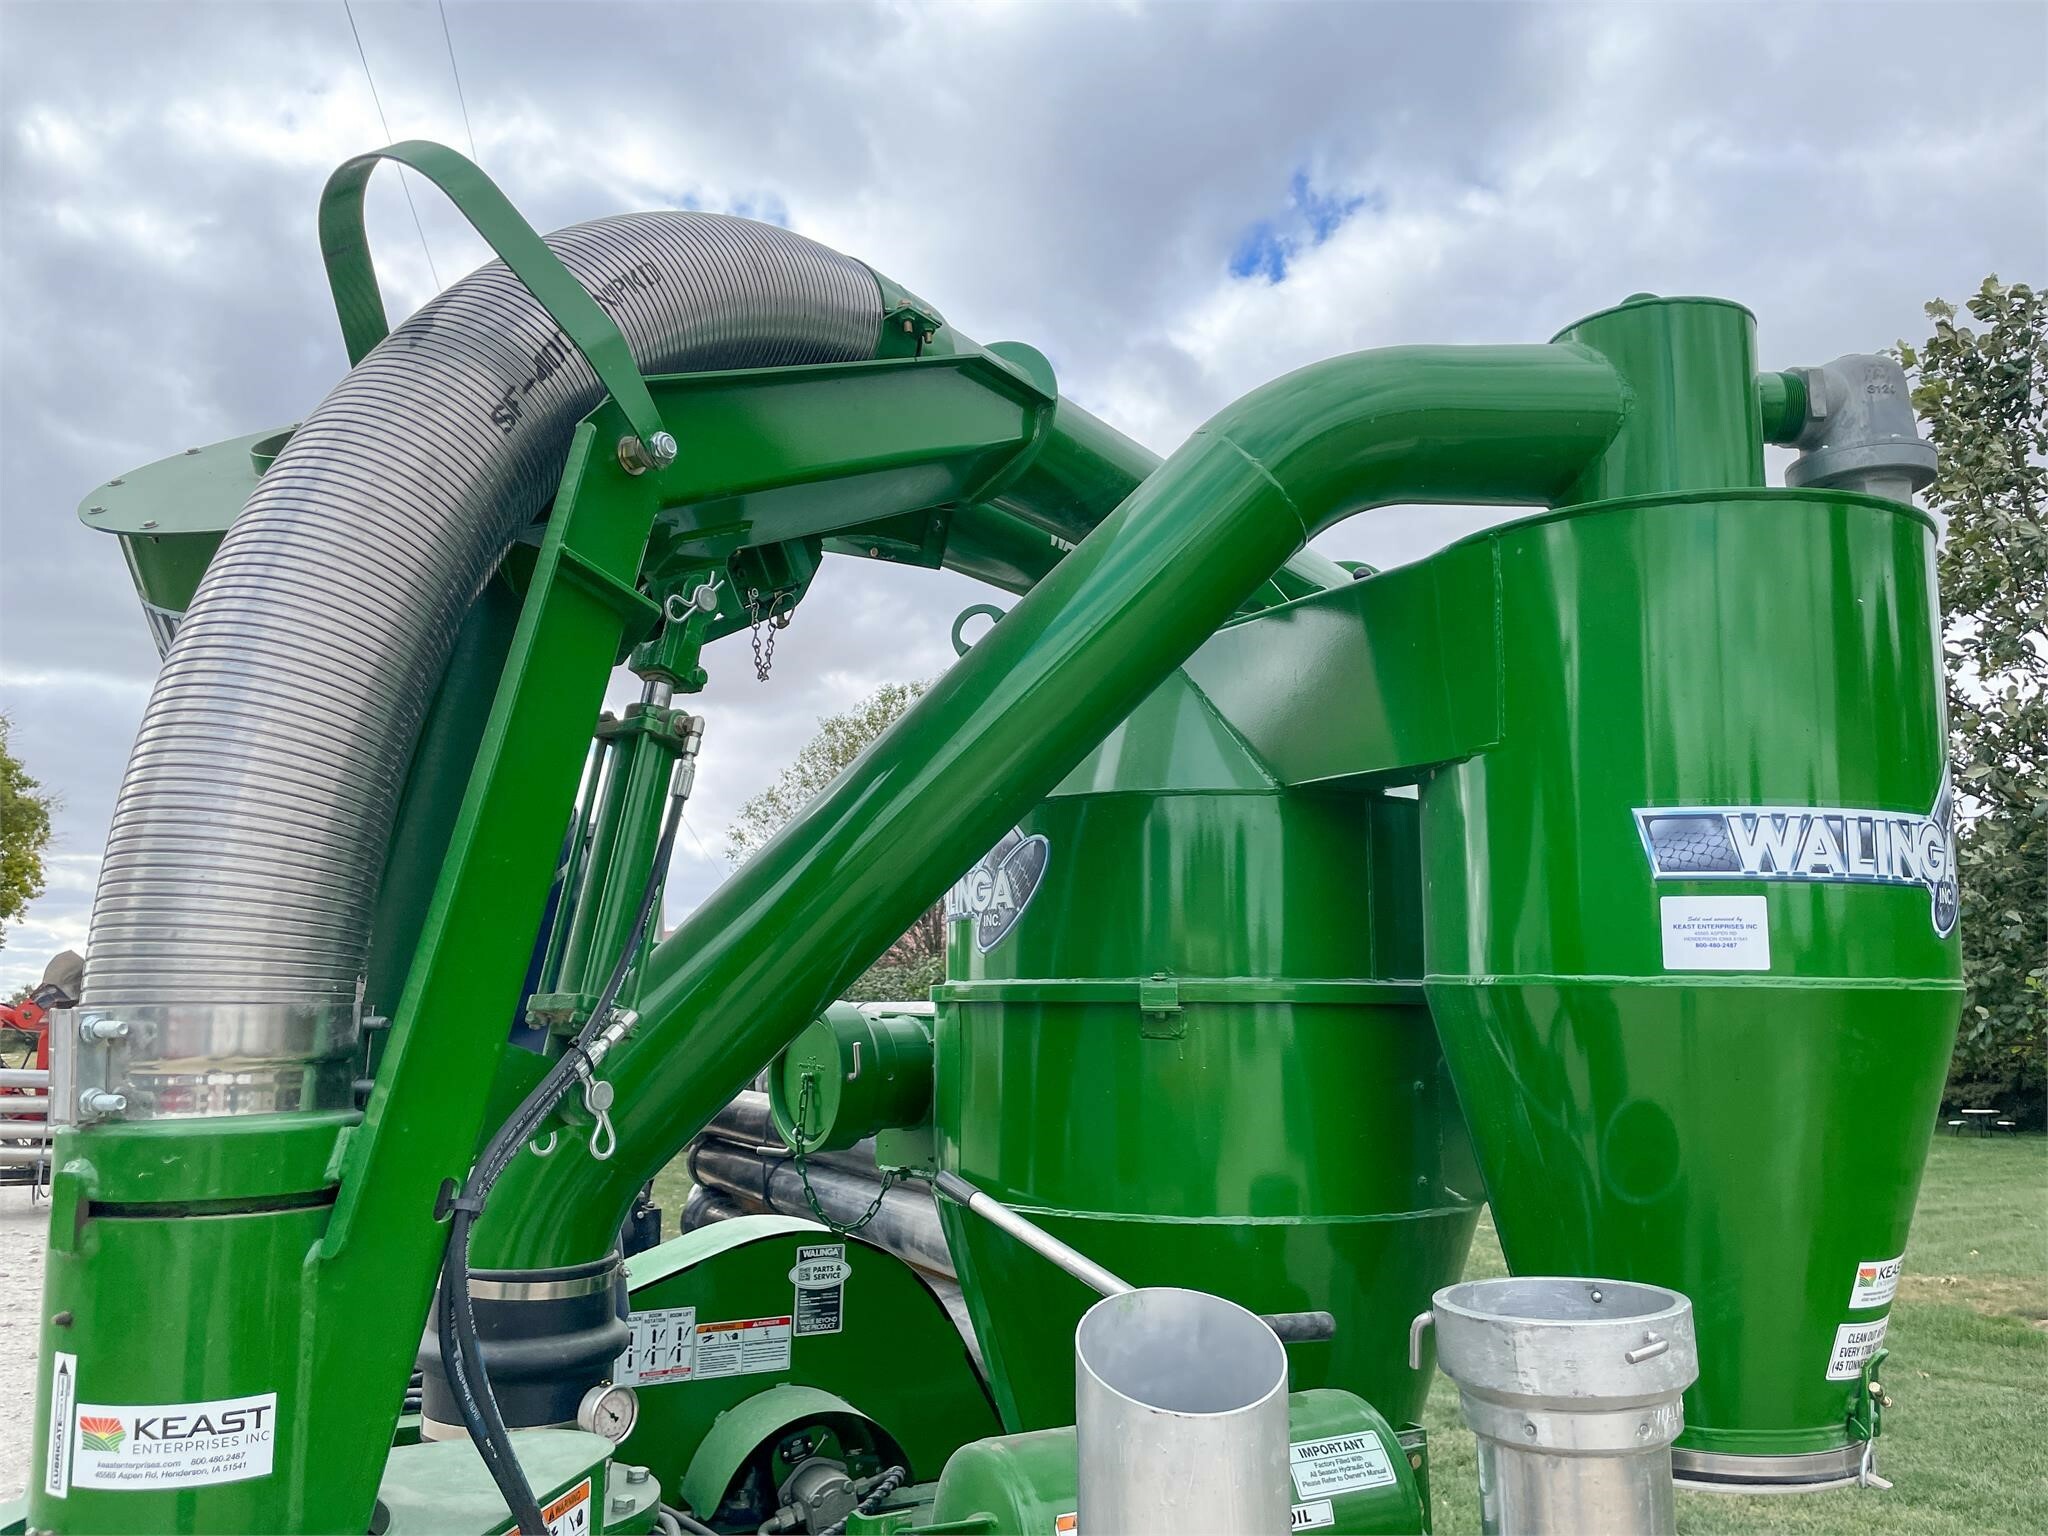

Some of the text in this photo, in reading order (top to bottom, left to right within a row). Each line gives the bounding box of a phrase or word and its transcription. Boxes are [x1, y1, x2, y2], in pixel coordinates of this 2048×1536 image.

[1726, 814, 1957, 884] WALINGA
[983, 914, 1001, 927] INC.
[803, 1248, 839, 1258] WALINGA
[812, 1264, 842, 1273] PARTS &
[813, 1272, 841, 1281] SERVICE
[815, 1316, 838, 1324] BEYOND
[1848, 1331, 1868, 1344] CLEAN
[1839, 1346, 1860, 1358] EVERY
[1831, 1360, 1844, 1374] (45
[134, 1405, 272, 1441] KEAST
[132, 1430, 271, 1455] ENTERPRISES INC
[1298, 1438, 1366, 1458] IMPORTANT
[53, 1421, 63, 1485] LUBRICATE
[1314, 1455, 1364, 1468] Factory Filled With
[118, 1471, 143, 1481] Aspen
[160, 1467, 209, 1479] Henderson,
[211, 1464, 221, 1474] IA
[222, 1461, 247, 1473] 51541
[1302, 1478, 1321, 1488] Please
[1321, 1476, 1337, 1485] Refer
[1337, 1475, 1344, 1483] to
[1343, 1472, 1367, 1482] Owner's
[1366, 1467, 1387, 1478] Manual
[1317, 1467, 1339, 1478] Season
[1338, 1463, 1364, 1475] Hydraulic
